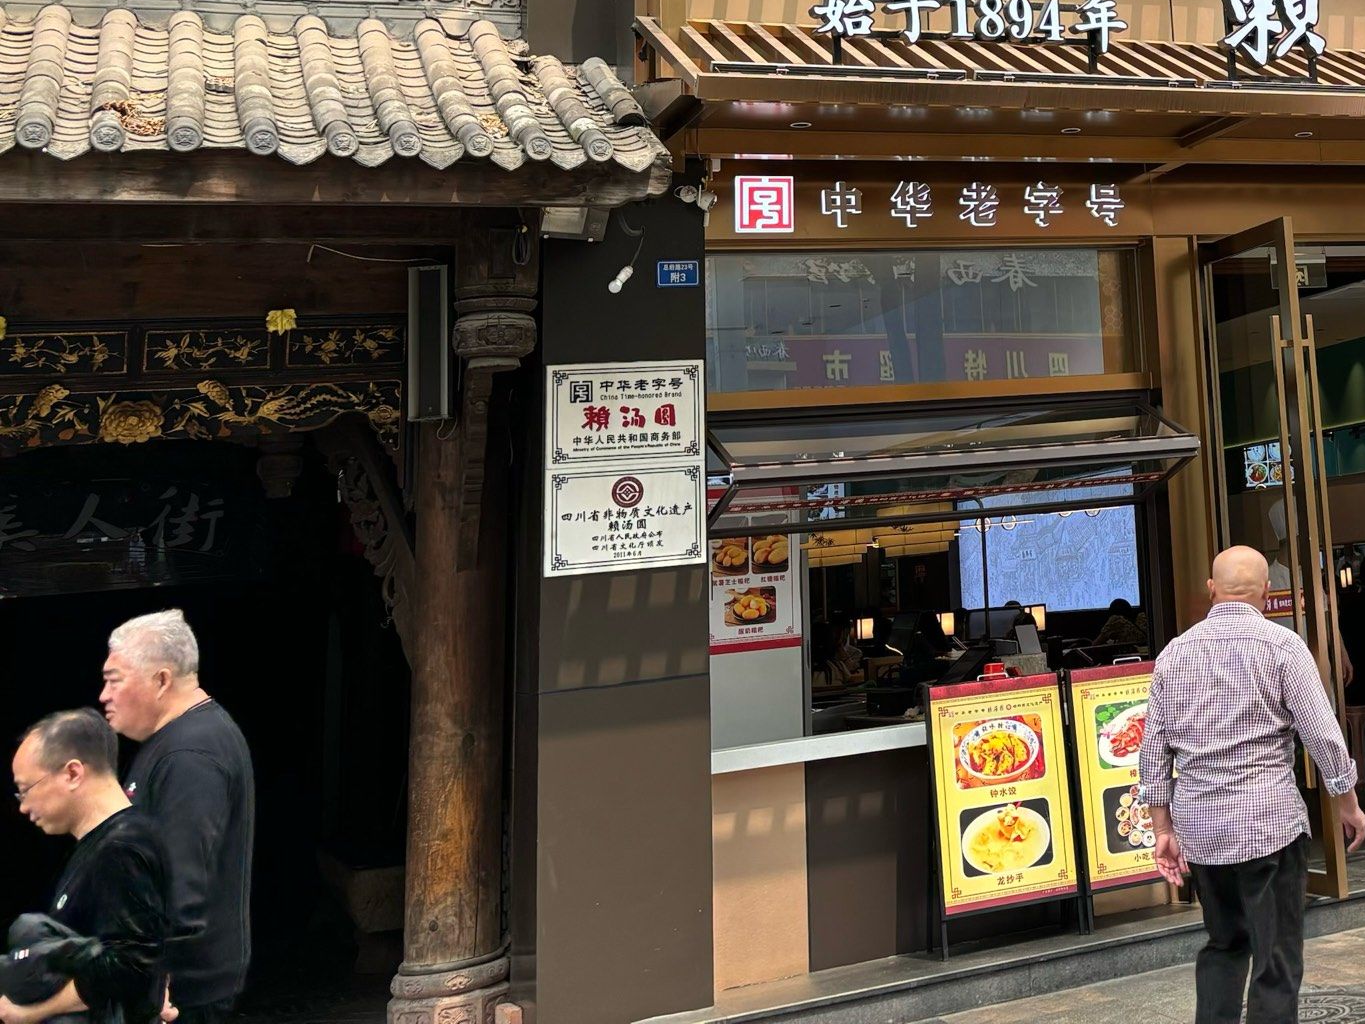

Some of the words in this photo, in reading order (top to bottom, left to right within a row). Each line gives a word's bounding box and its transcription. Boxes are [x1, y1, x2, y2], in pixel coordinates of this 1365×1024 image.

[821, 180, 1125, 227] 中华老字号
[600, 377, 683, 392] 中华老字号
[573, 431, 681, 446] 中华人民共和国商务部
[561, 502, 693, 522] 四川省非物质文化遗产
[592, 531, 663, 542] 四川省人民政府公布
